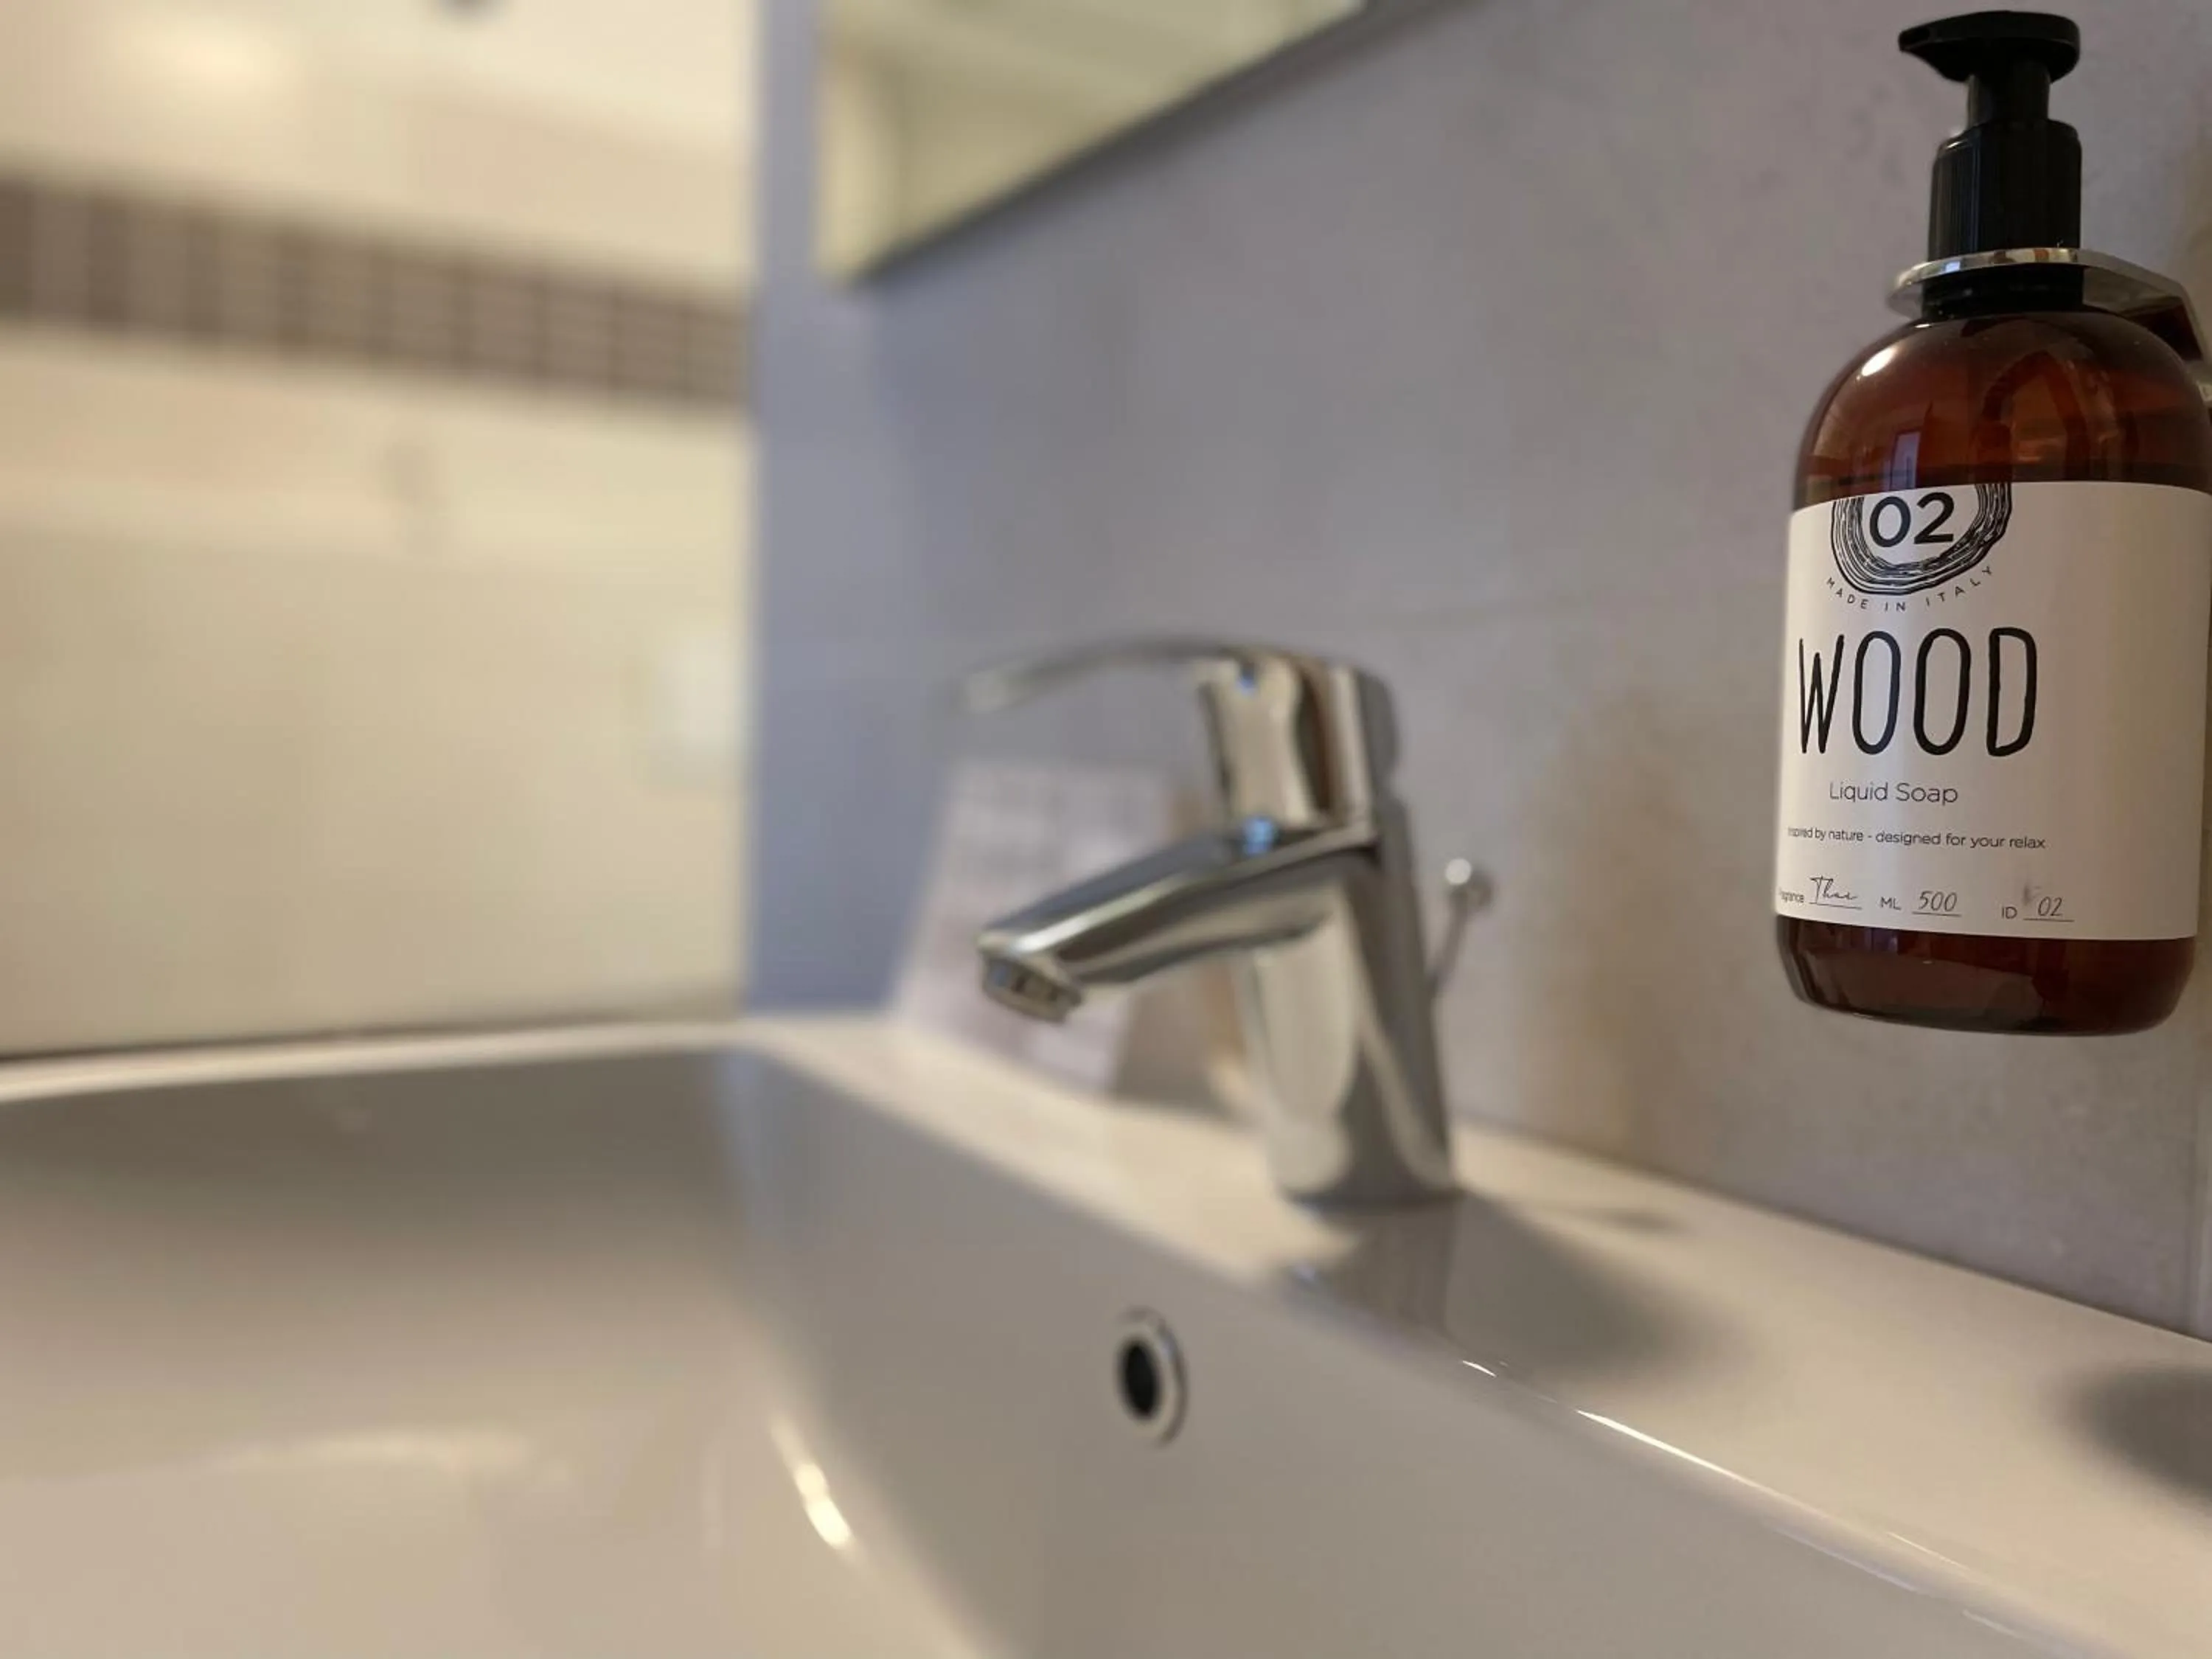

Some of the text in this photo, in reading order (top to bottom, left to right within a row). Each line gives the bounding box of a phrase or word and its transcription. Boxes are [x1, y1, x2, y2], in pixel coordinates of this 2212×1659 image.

[1869, 492, 1955, 548] 02
[1826, 566, 1993, 612] MADE IN ITALY
[1799, 627, 2037, 757] WOOD
[1829, 782, 1958, 805] Liquid Soap
[1815, 828, 1826, 841] by
[1828, 830, 1864, 841] nature
[1876, 830, 1941, 846] designed
[1946, 833, 1966, 846] for
[1970, 836, 2005, 848] your
[2009, 836, 2045, 848] relax
[1881, 897, 1902, 910] ML
[1919, 890, 1958, 911] 500
[2001, 906, 2017, 919] ID
[2037, 896, 2064, 916] 02
